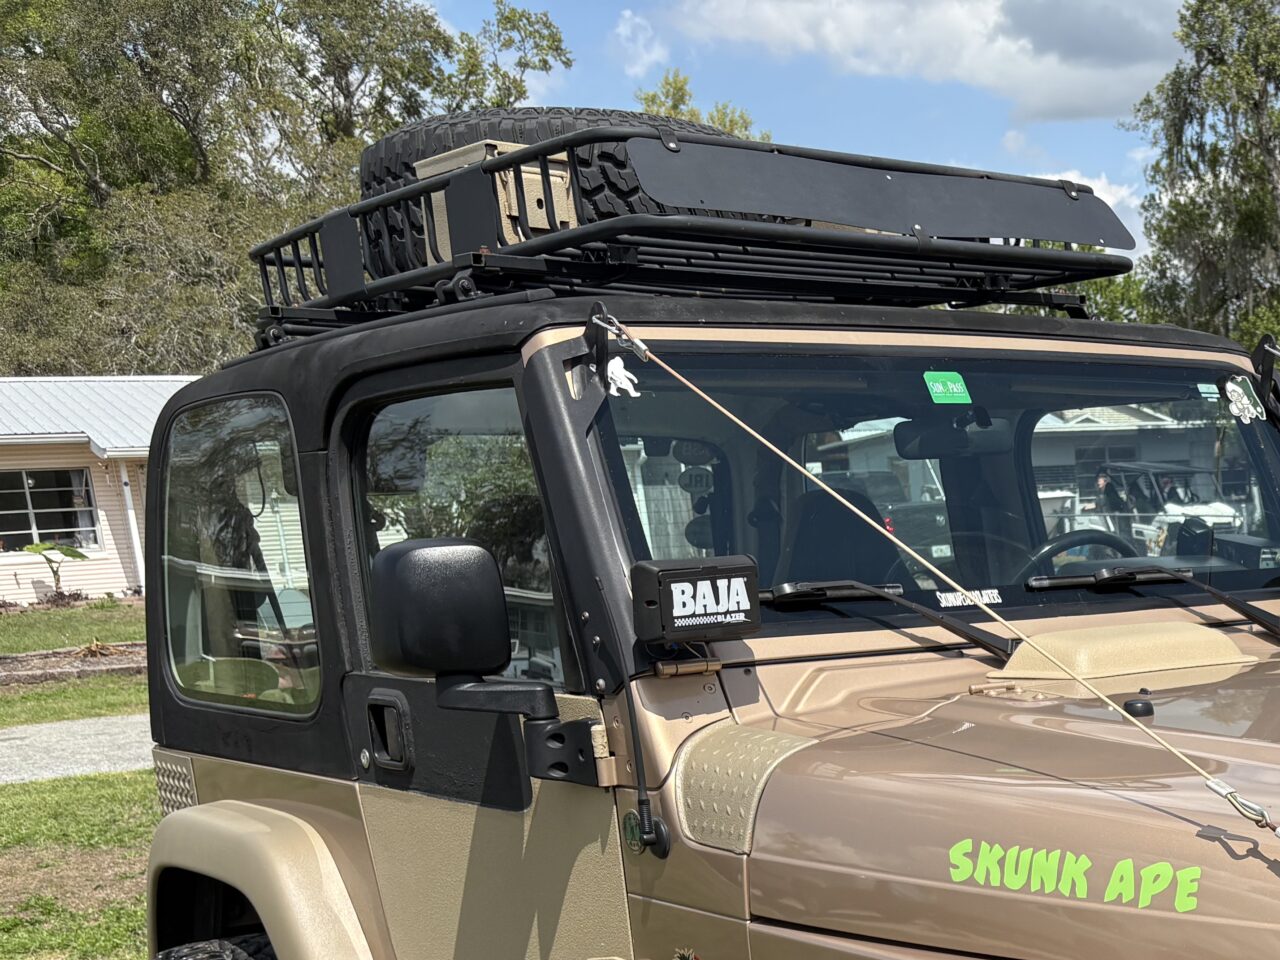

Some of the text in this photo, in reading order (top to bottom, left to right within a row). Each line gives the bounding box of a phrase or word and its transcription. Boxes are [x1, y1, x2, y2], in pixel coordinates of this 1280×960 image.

[670, 577, 751, 617] BAJA
[716, 612, 746, 623] BLAZER
[949, 838, 1202, 914] SKUNK APE
